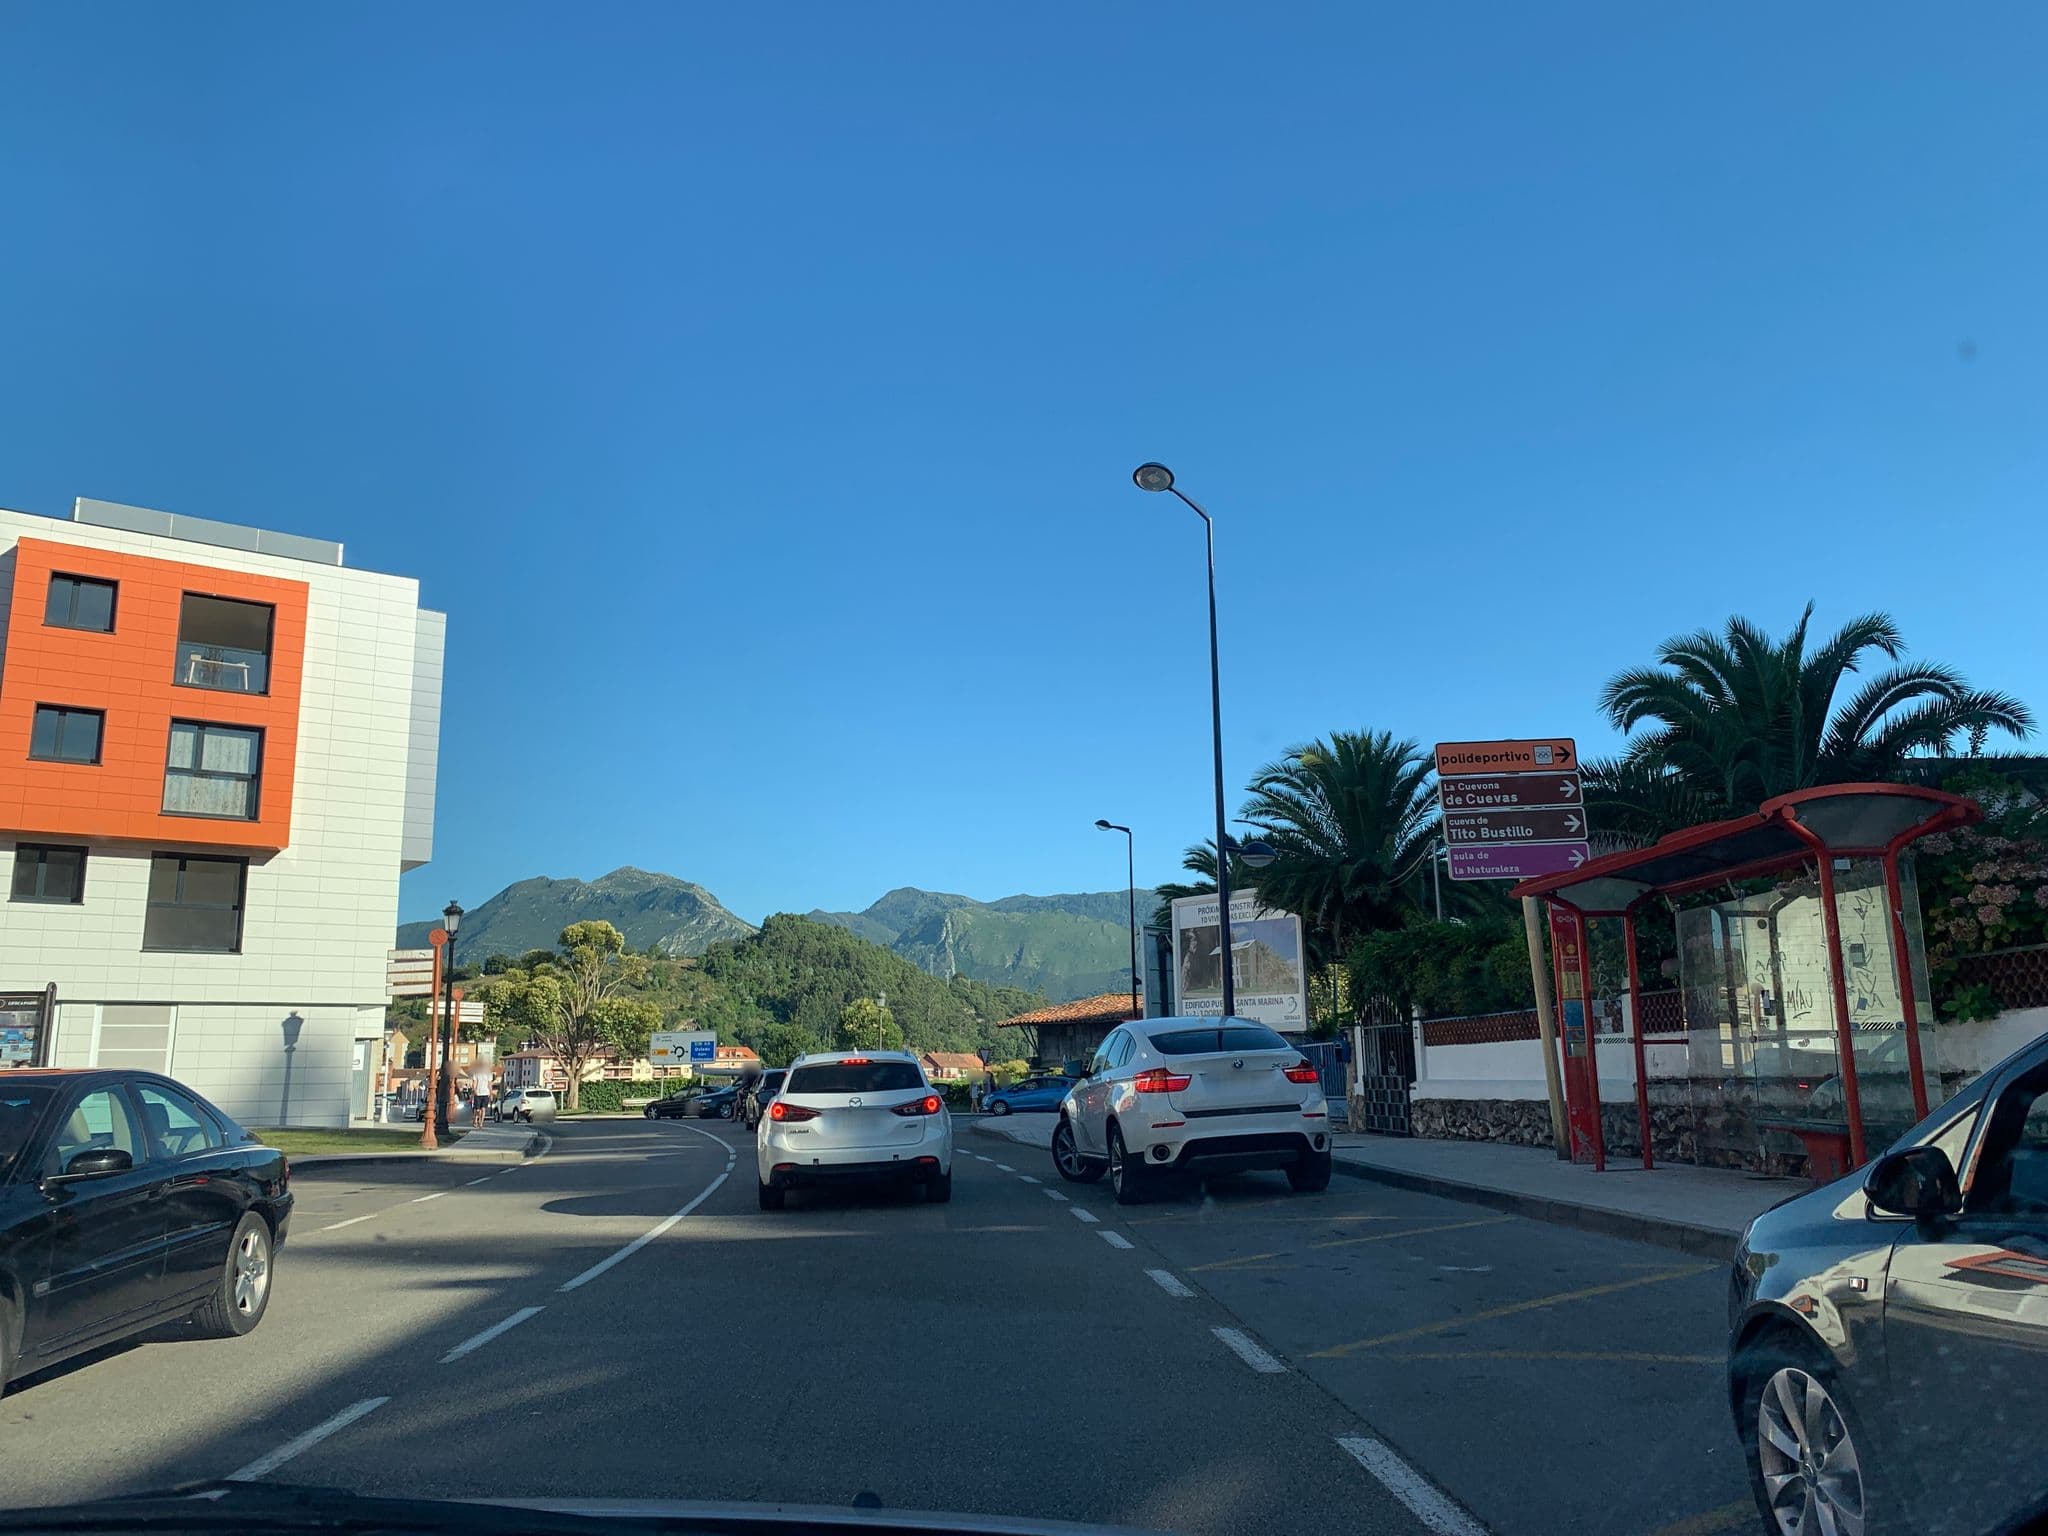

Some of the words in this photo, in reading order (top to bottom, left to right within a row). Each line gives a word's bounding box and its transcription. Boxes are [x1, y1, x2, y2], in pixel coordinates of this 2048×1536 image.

[1441, 751, 1530, 766] polideportivo
[1444, 783, 1455, 792] La
[1458, 782, 1500, 791] Cuevona
[1446, 794, 1462, 805] de
[1466, 793, 1518, 804] Cuevas
[1449, 818, 1476, 826] cueva
[1477, 816, 1488, 825] de
[1449, 828, 1476, 840] Tito
[1480, 826, 1533, 839] Bustillo
[1453, 852, 1474, 860] aula
[1477, 851, 1489, 859] de
[1454, 866, 1464, 875] la
[1467, 865, 1520, 874] Naturaleza
[1185, 1000, 1210, 1010] EDIFICIO
[1236, 998, 1257, 1007] SANTA
[1257, 997, 1284, 1006] MARINA
